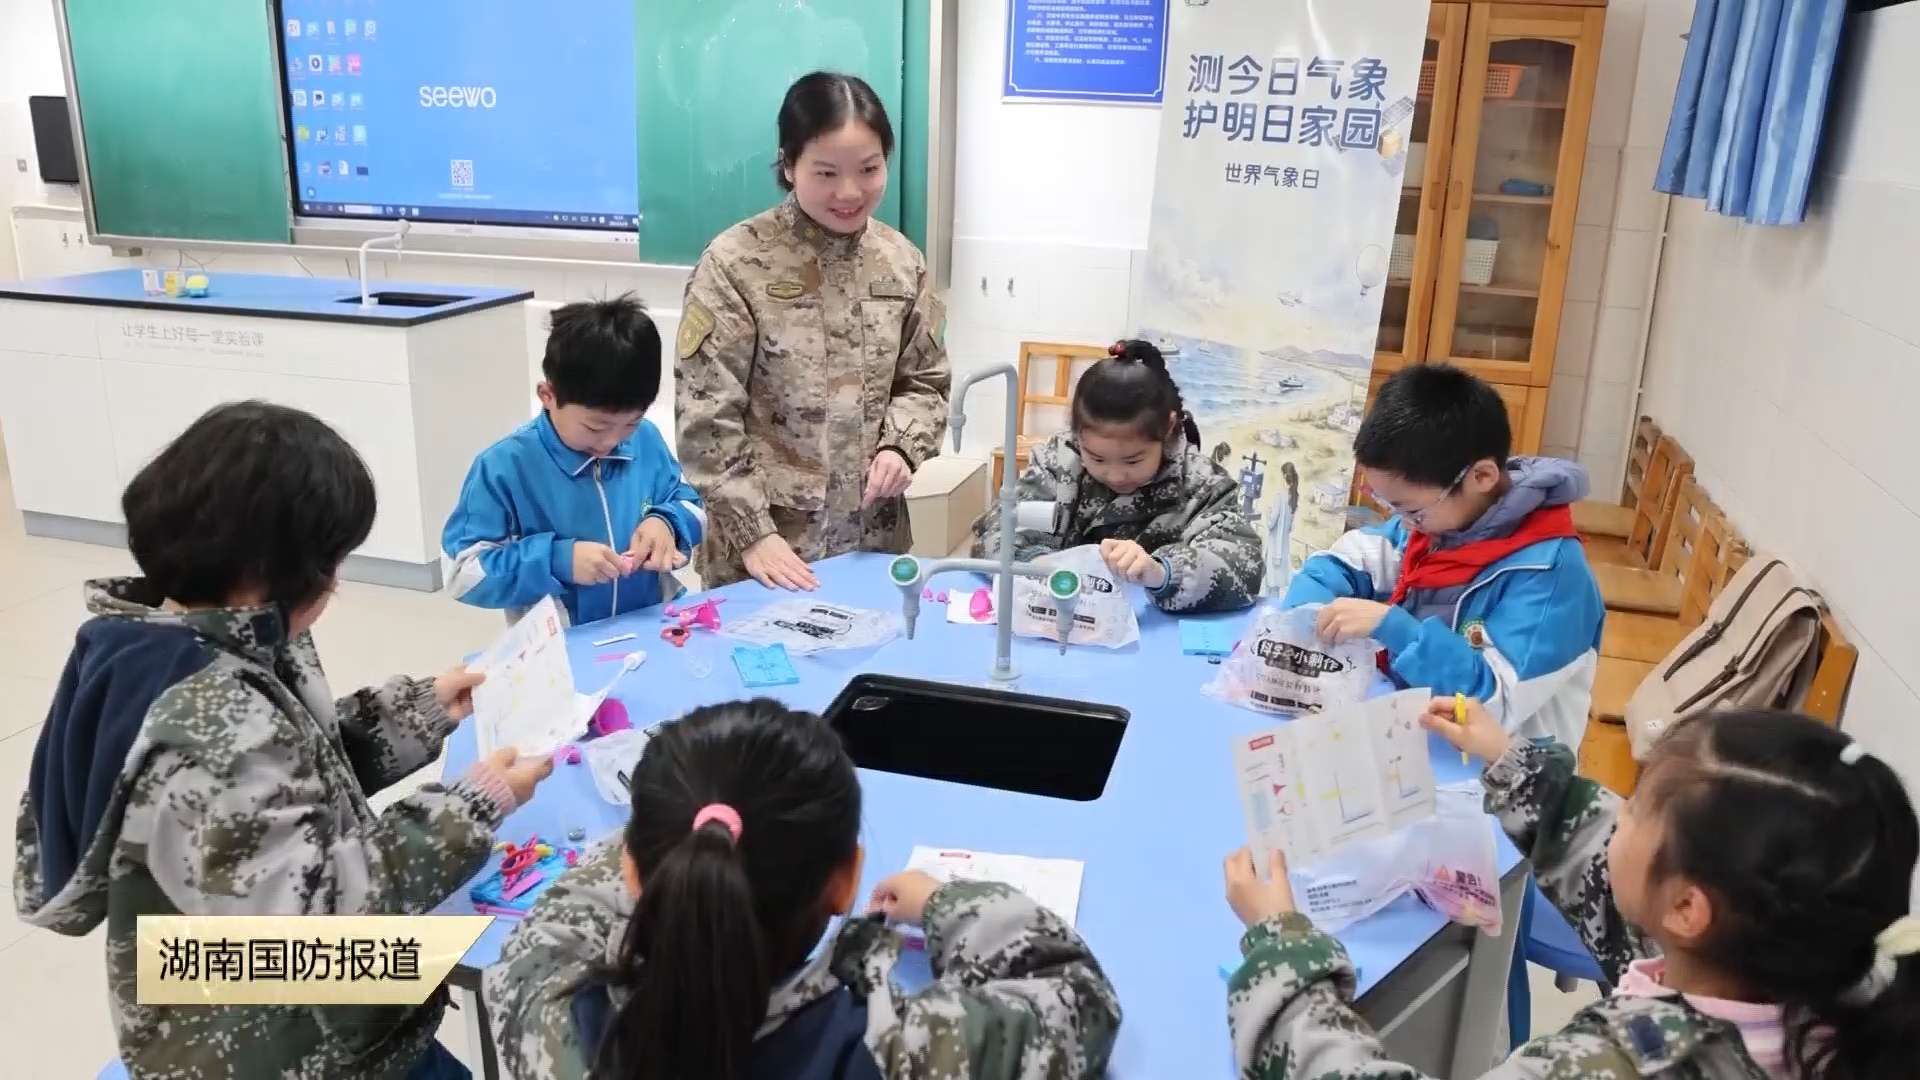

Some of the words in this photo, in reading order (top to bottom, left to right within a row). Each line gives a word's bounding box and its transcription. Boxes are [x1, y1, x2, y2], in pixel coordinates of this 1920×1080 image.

[1187, 54, 1388, 101] 测今日气象
[419, 86, 497, 108] seewo
[1182, 99, 1382, 149] 护明日家园
[1225, 162, 1320, 189] 世界气象日
[121, 322, 266, 347] 让学生上好每一堂实验课
